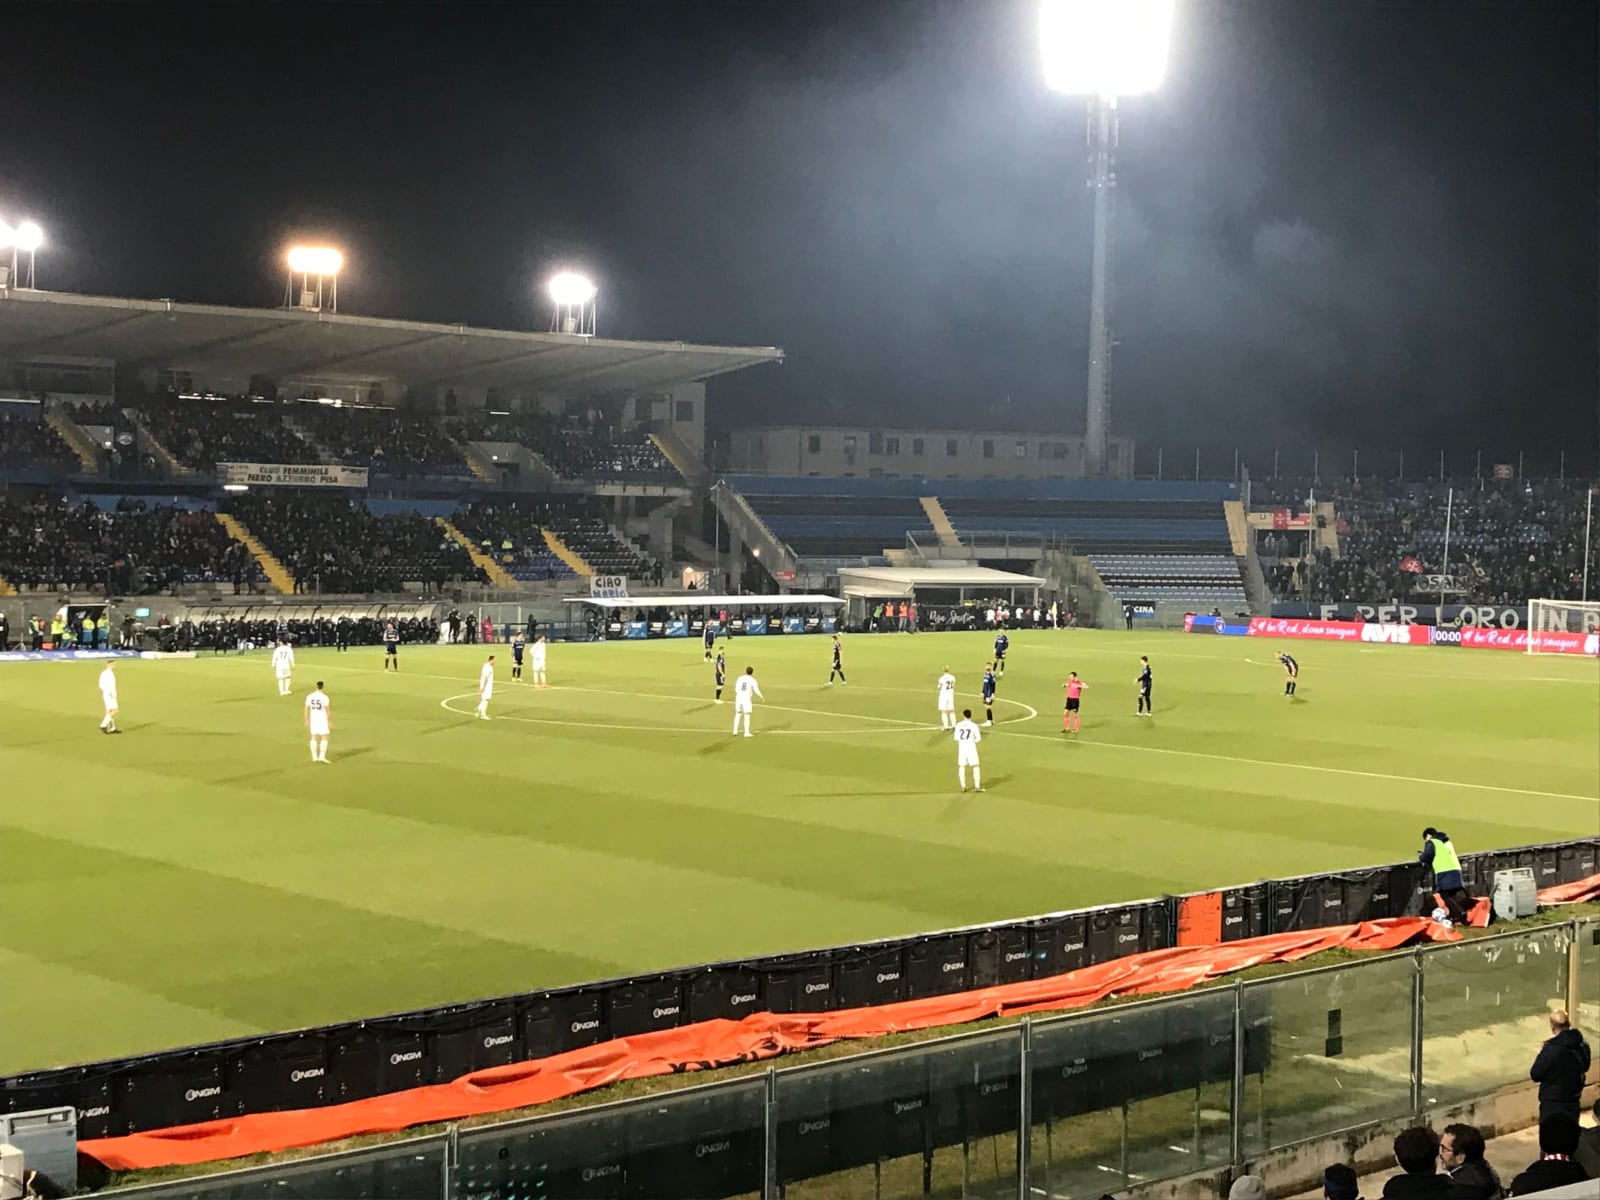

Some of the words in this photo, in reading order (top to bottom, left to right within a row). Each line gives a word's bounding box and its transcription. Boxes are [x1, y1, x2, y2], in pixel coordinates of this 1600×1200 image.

[283, 467, 329, 475] FEMMINILE
[247, 474, 273, 482] NERO
[595, 577, 622, 588] CIAO
[1356, 604, 1418, 625] PER
[1434, 606, 1519, 630] LORO
[1361, 623, 1411, 643] AVIS
[1435, 630, 1461, 642] 00:00
[311, 699, 322, 710] 55
[959, 728, 971, 740] 27
